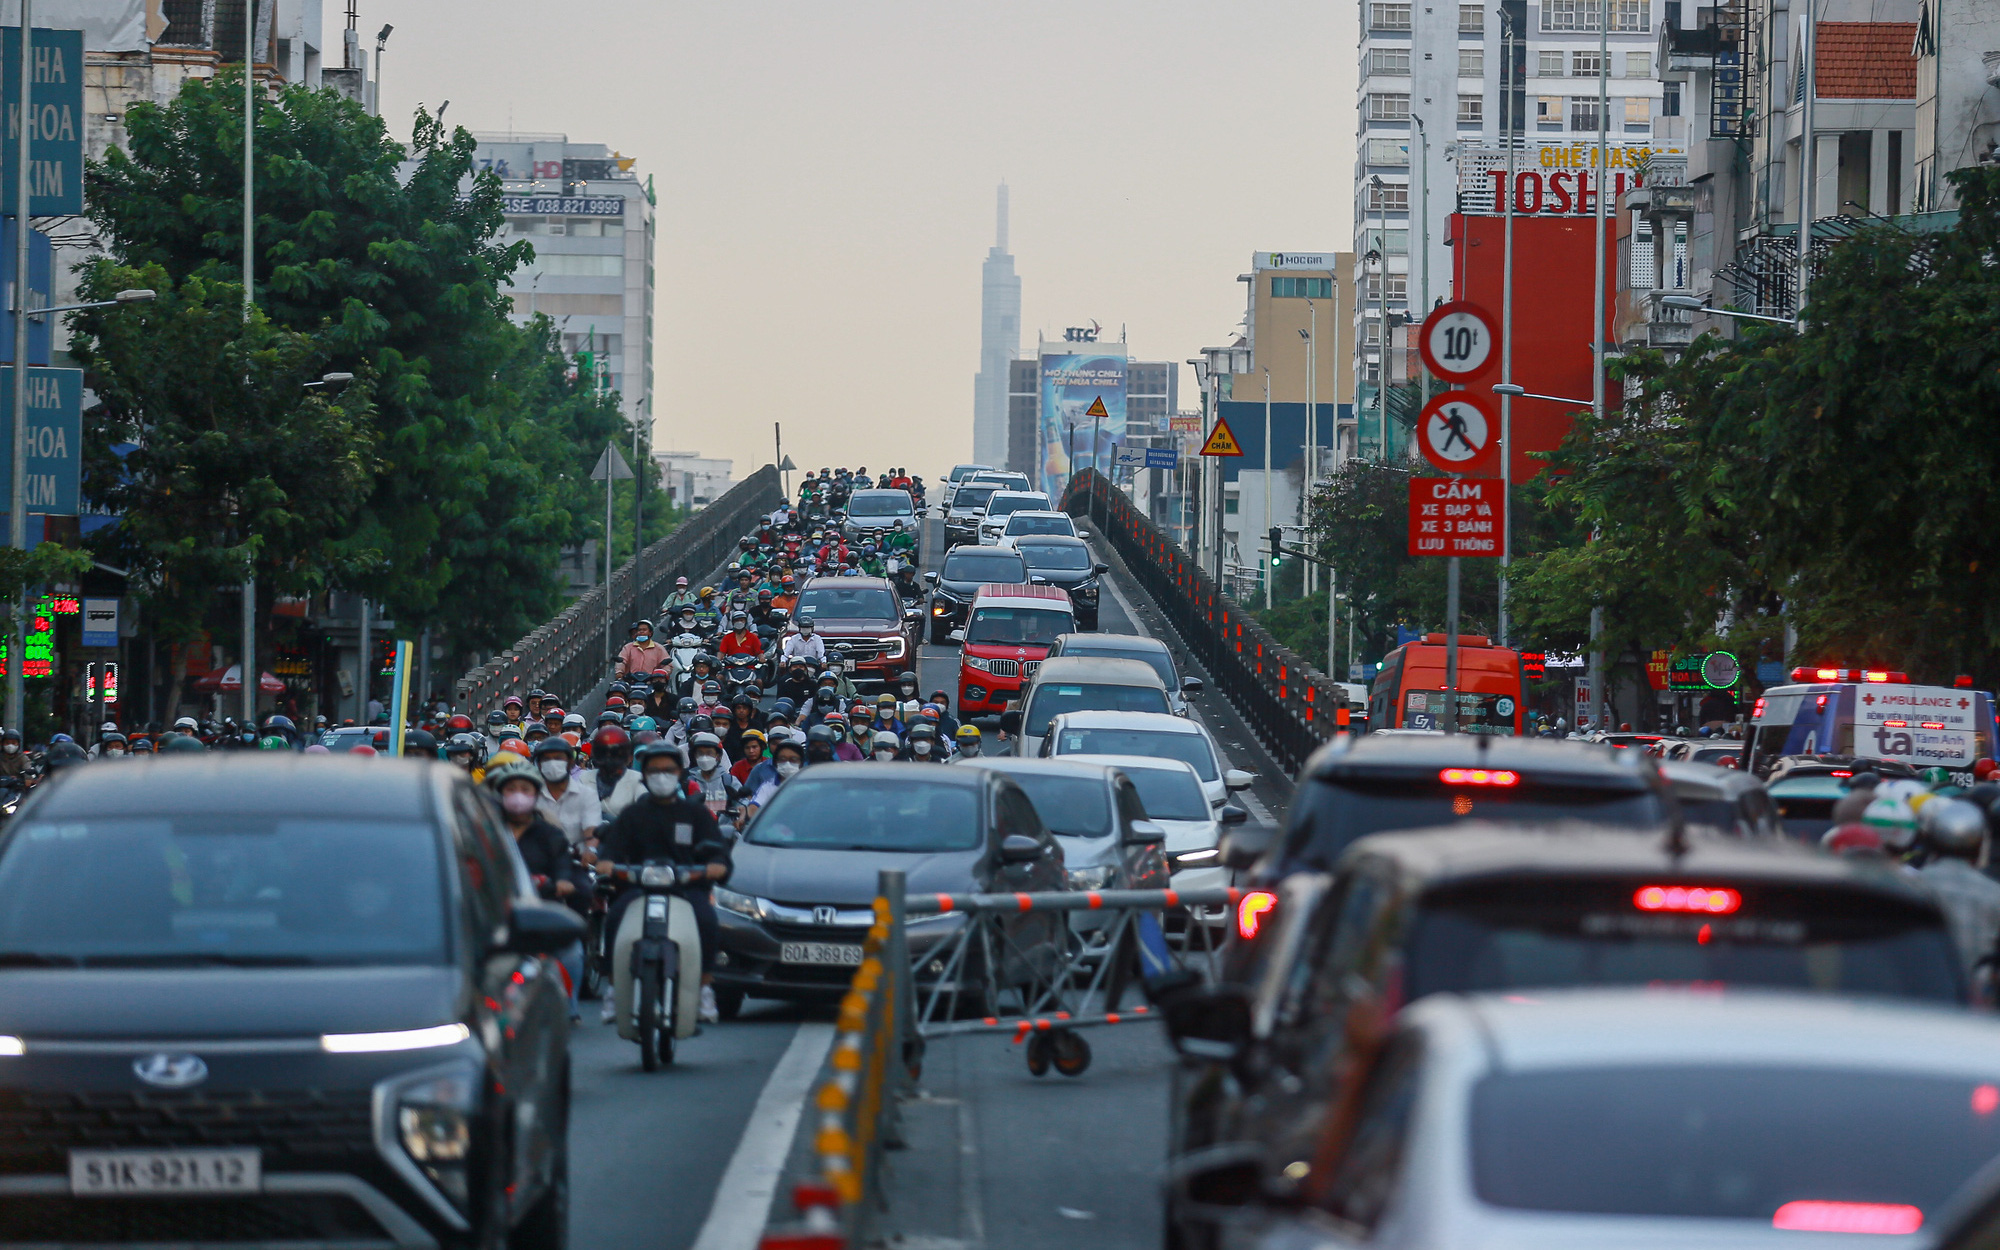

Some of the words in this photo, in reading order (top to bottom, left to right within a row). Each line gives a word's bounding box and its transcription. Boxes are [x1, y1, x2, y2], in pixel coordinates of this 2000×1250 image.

[1487, 170, 1642, 214] TOSHI
[1433, 477, 1482, 500] CẤM
[1421, 504, 1439, 516] XE
[1476, 501, 1492, 516] VÀ
[1421, 520, 1438, 532] XE
[1443, 520, 1453, 532] 3
[1457, 517, 1492, 533] BÁNH
[1881, 695, 1952, 707] AMBULANCE
[1873, 727, 1912, 755] ta
[1915, 733, 1939, 744] Tâm
[1941, 735, 1965, 745] Anh
[1915, 747, 1965, 760] Hospital
